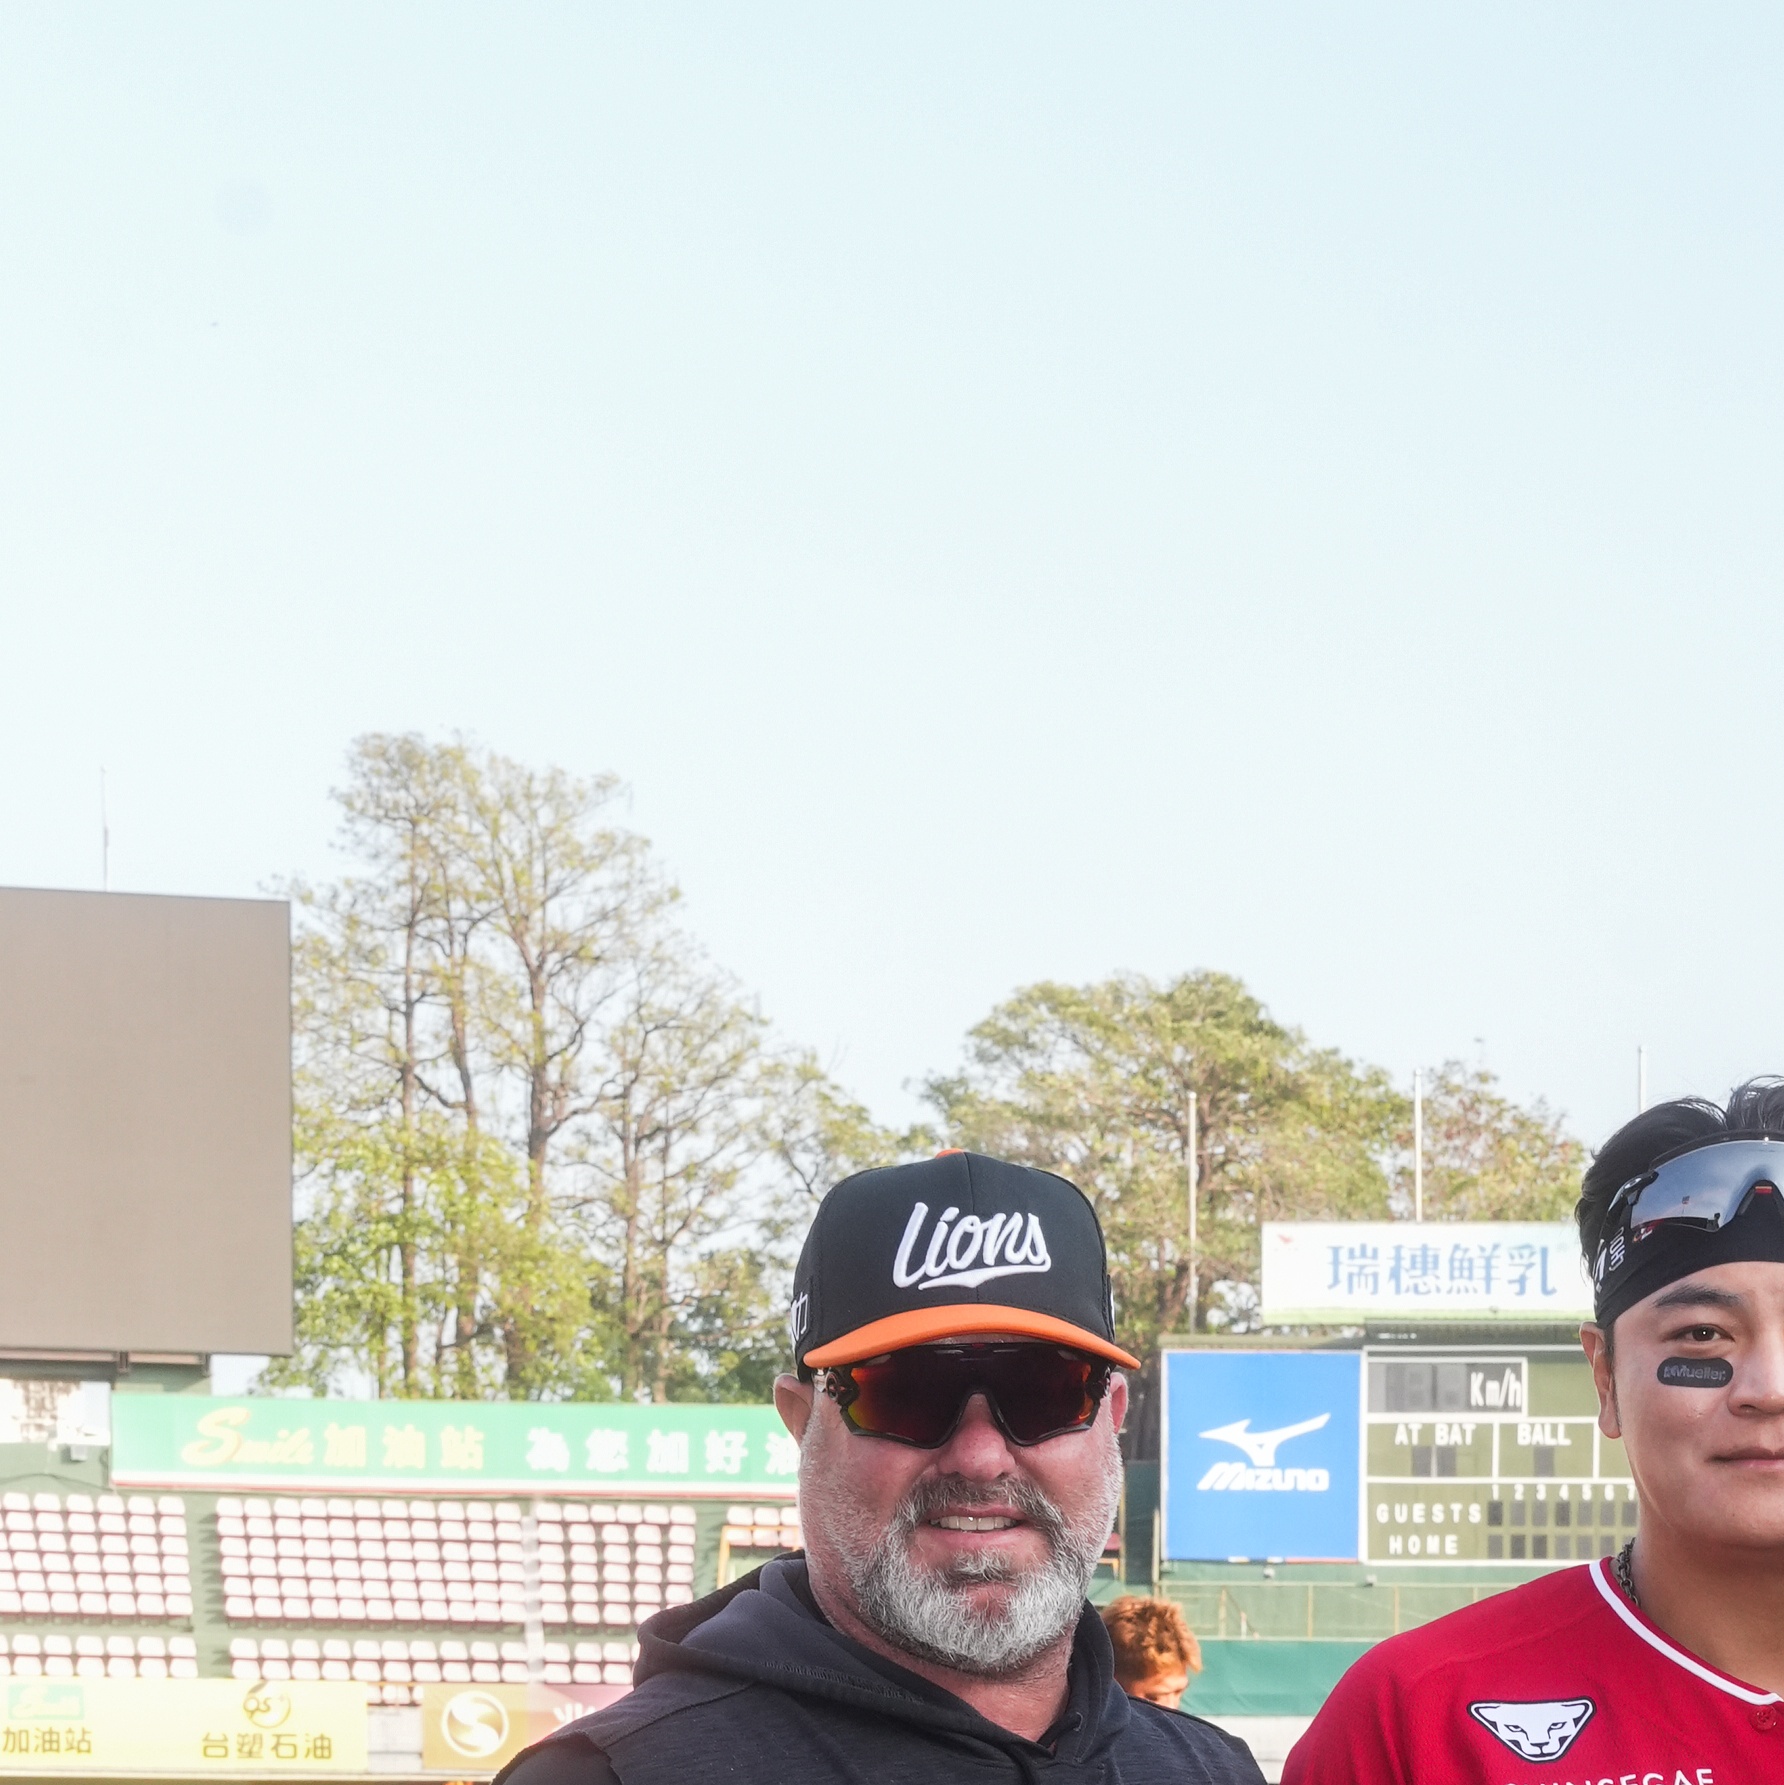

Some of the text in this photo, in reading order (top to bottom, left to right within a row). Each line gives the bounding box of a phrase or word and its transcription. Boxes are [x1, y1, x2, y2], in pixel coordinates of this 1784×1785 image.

[893, 1201, 1052, 1290] Lions
[1326, 1243, 1558, 1297] 瑞穗鮮乳
[1470, 1367, 1522, 1408] Km/h
[324, 1423, 486, 1470] 加油站
[1394, 1423, 1477, 1446] AT BAT
[1517, 1423, 1572, 1446] BALL
[1492, 1484, 1500, 1501] 1
[1514, 1484, 1524, 1501] 2
[1536, 1484, 1546, 1501] 3
[1559, 1484, 1569, 1501] 4
[1582, 1484, 1592, 1501] 5
[1604, 1484, 1615, 1501] 6
[1376, 1503, 1481, 1523] GUESTS
[1389, 1535, 1458, 1555] HOME
[2, 1726, 93, 1755] 加油站
[202, 1732, 333, 1760] 台塑石油
